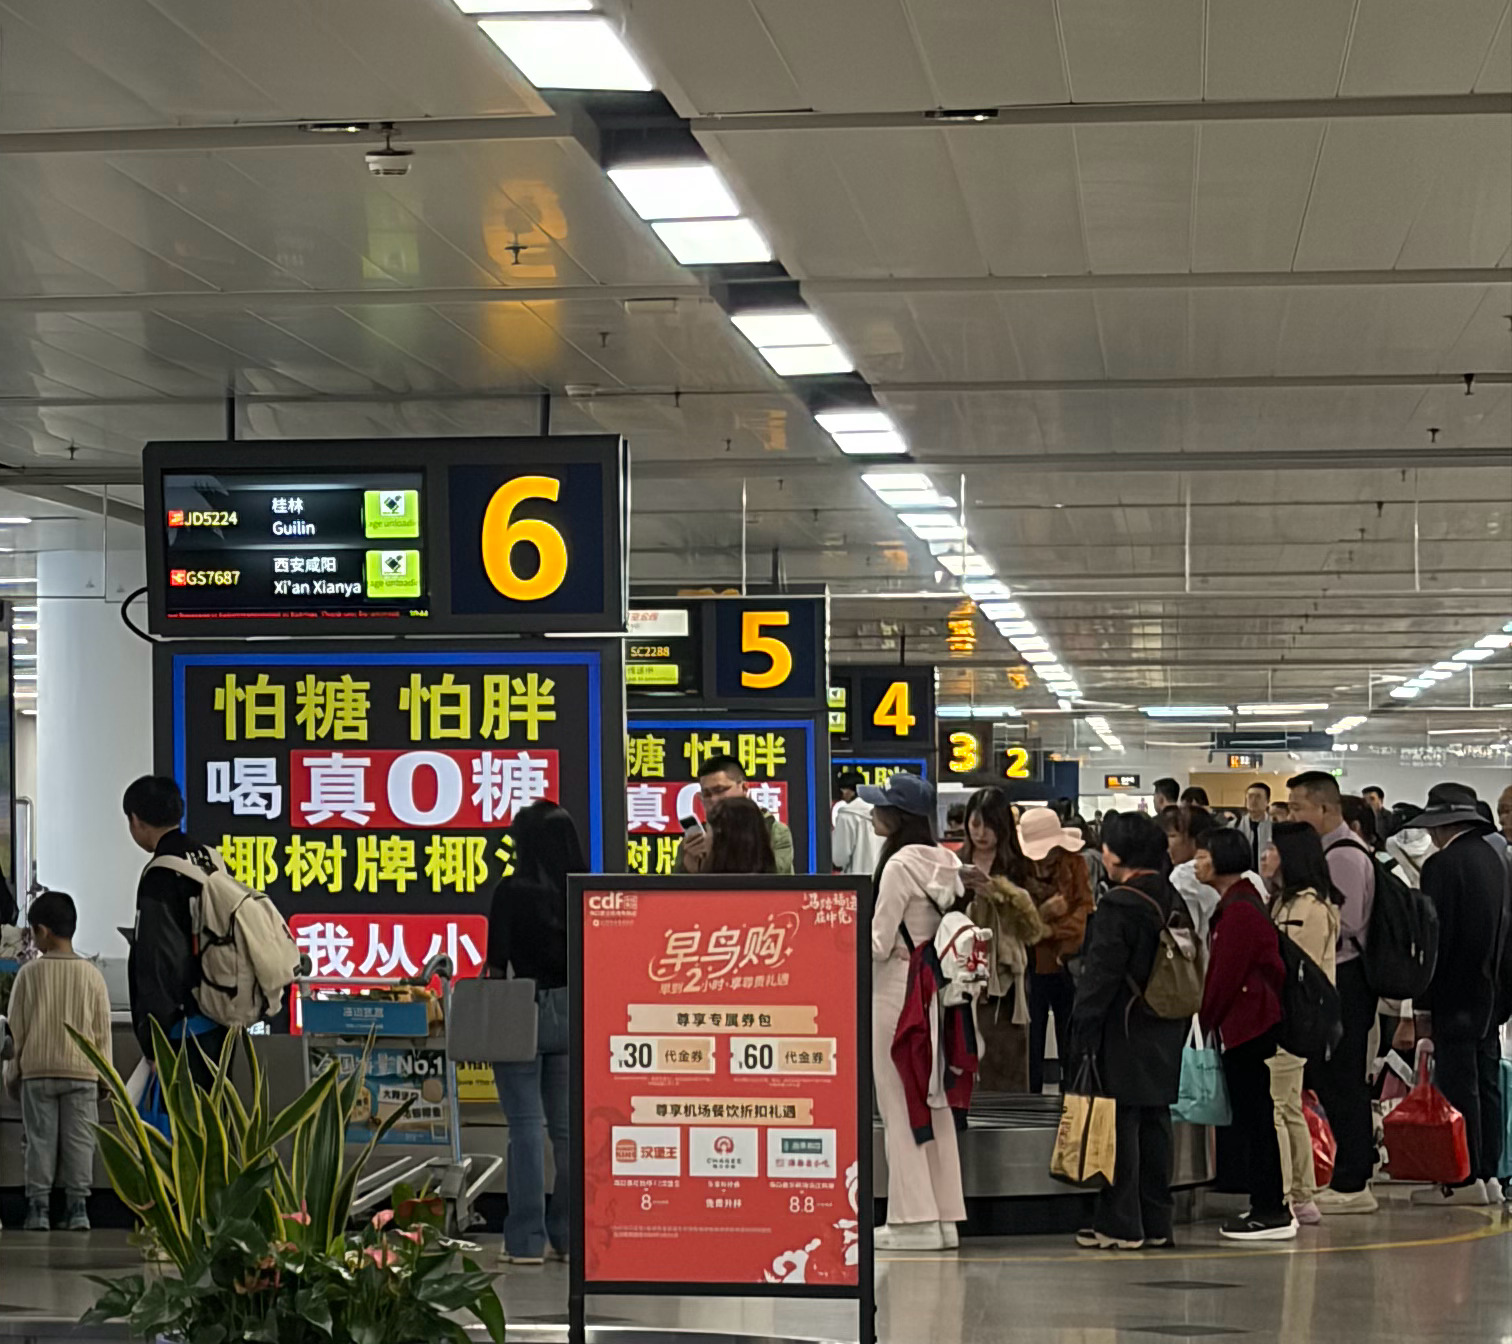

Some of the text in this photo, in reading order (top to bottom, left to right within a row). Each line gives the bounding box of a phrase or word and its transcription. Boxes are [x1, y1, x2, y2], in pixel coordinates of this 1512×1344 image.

[271, 496, 304, 515] 桂林
[184, 511, 238, 526] JD5224
[273, 520, 316, 536] Guilin
[481, 475, 569, 602] 6
[273, 556, 337, 573] 西安咸阳
[186, 570, 241, 586] GS7687
[274, 579, 362, 598] Xi'an Xianya
[740, 611, 792, 689] 5
[213, 672, 558, 742] 怕糖 怕胖
[873, 682, 916, 737] 4
[949, 732, 976, 773] 3
[1006, 747, 1030, 778] 2
[588, 891, 624, 910] cdf
[295, 922, 484, 978] 我从小
[659, 923, 786, 979] 早鸟购
[664, 1049, 704, 1064] 代金券
[785, 1050, 824, 1065] 代金券
[640, 1193, 652, 1211] 8
